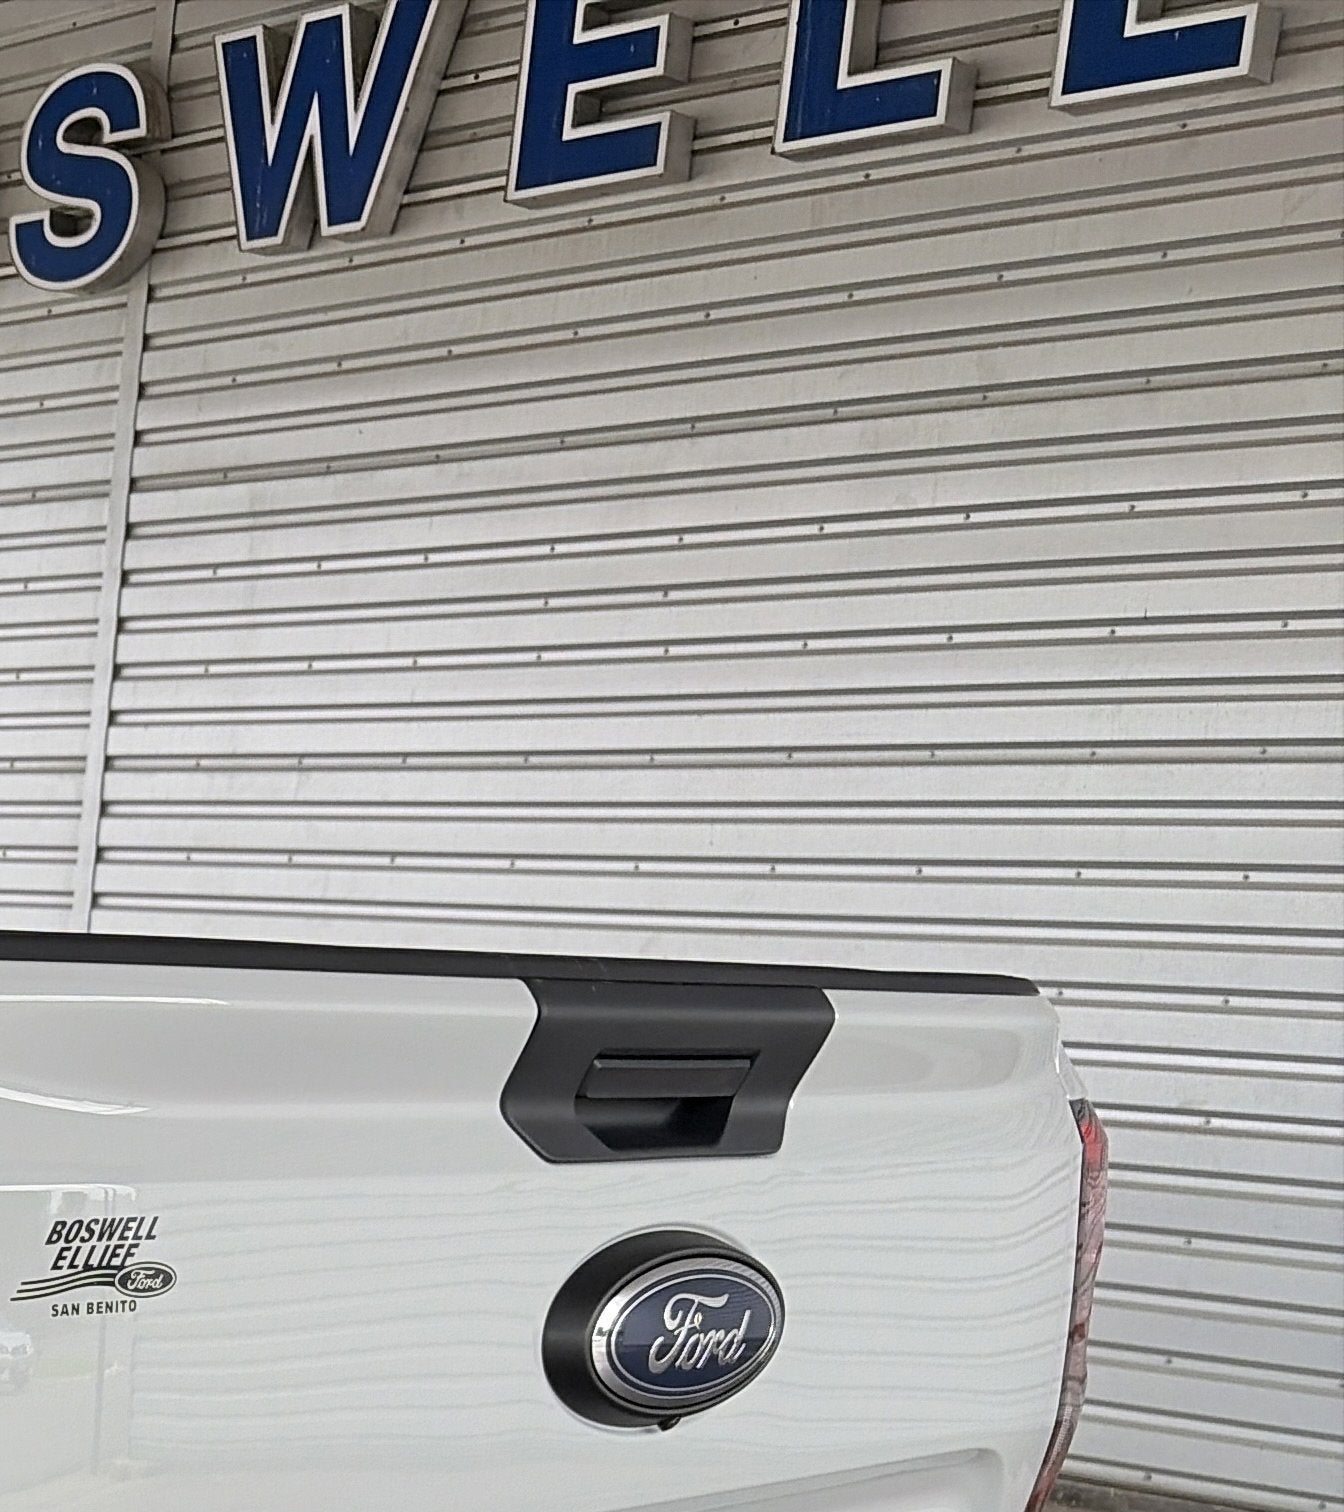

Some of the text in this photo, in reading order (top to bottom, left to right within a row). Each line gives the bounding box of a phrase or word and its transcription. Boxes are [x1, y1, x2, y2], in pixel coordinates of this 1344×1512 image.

[45, 1216, 159, 1246] BOSWELL
[50, 1243, 140, 1271] ELLIFF
[126, 1269, 164, 1290] Ford
[51, 1300, 137, 1317] SAN BENITO
[648, 1292, 751, 1375] Ford
